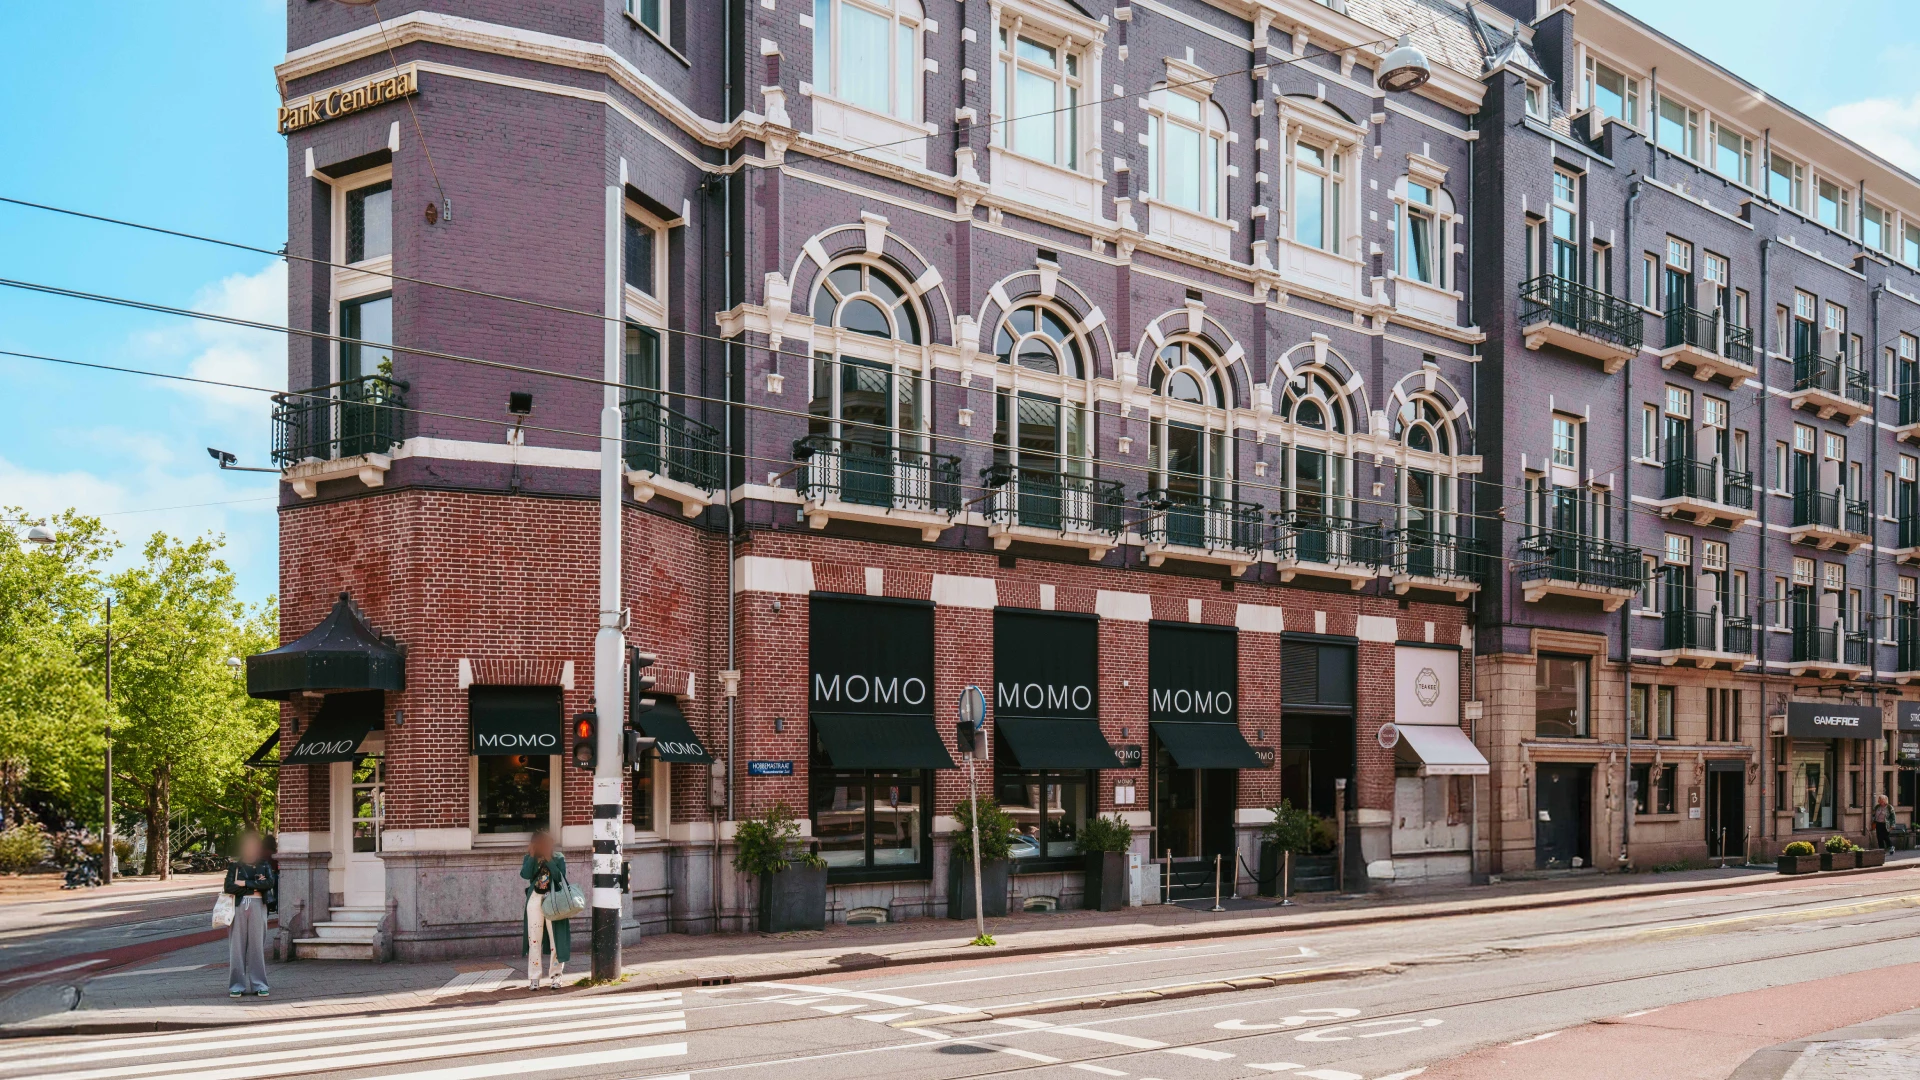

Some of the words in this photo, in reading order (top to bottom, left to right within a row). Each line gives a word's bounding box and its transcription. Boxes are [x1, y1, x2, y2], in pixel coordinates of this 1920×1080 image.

[277, 95, 325, 133] Park
[325, 62, 418, 117] Centraal
[814, 673, 926, 705] MOMO
[998, 682, 1092, 711] MOMO
[1153, 688, 1232, 715] MOMO
[1813, 715, 1860, 727] GAMEFACE
[294, 739, 353, 756] MOMO
[478, 733, 556, 747] MOMO
[657, 741, 703, 756] MOMO
